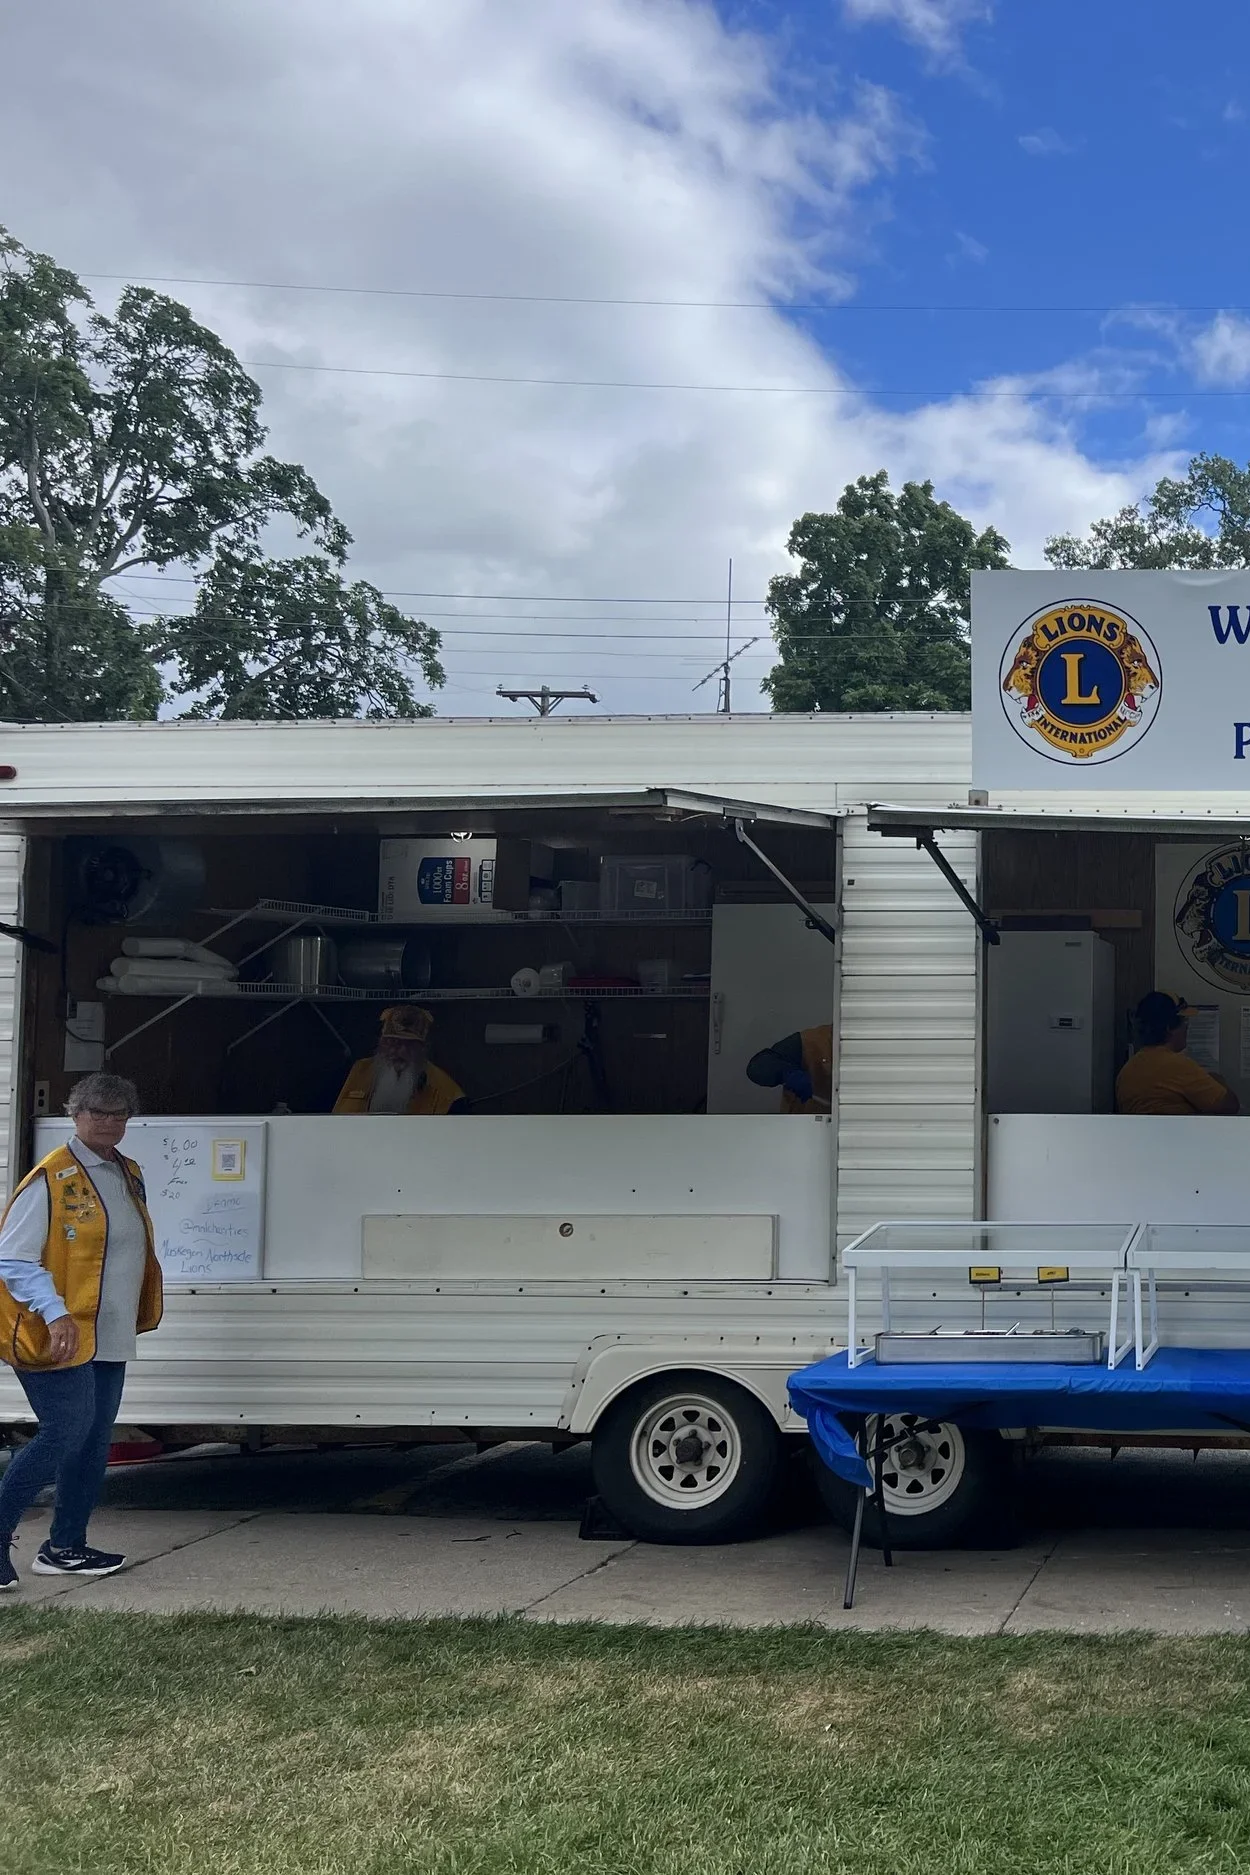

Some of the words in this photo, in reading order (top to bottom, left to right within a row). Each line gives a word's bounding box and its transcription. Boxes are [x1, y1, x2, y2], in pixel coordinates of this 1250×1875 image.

[1040, 612, 1120, 643] LIONS
[1060, 653, 1100, 705] L
[1036, 716, 1127, 744] INTERNATIONAL
[443, 860, 454, 880] Cups
[443, 882, 453, 903] Foam
[181, 1261, 212, 1273] Lions
